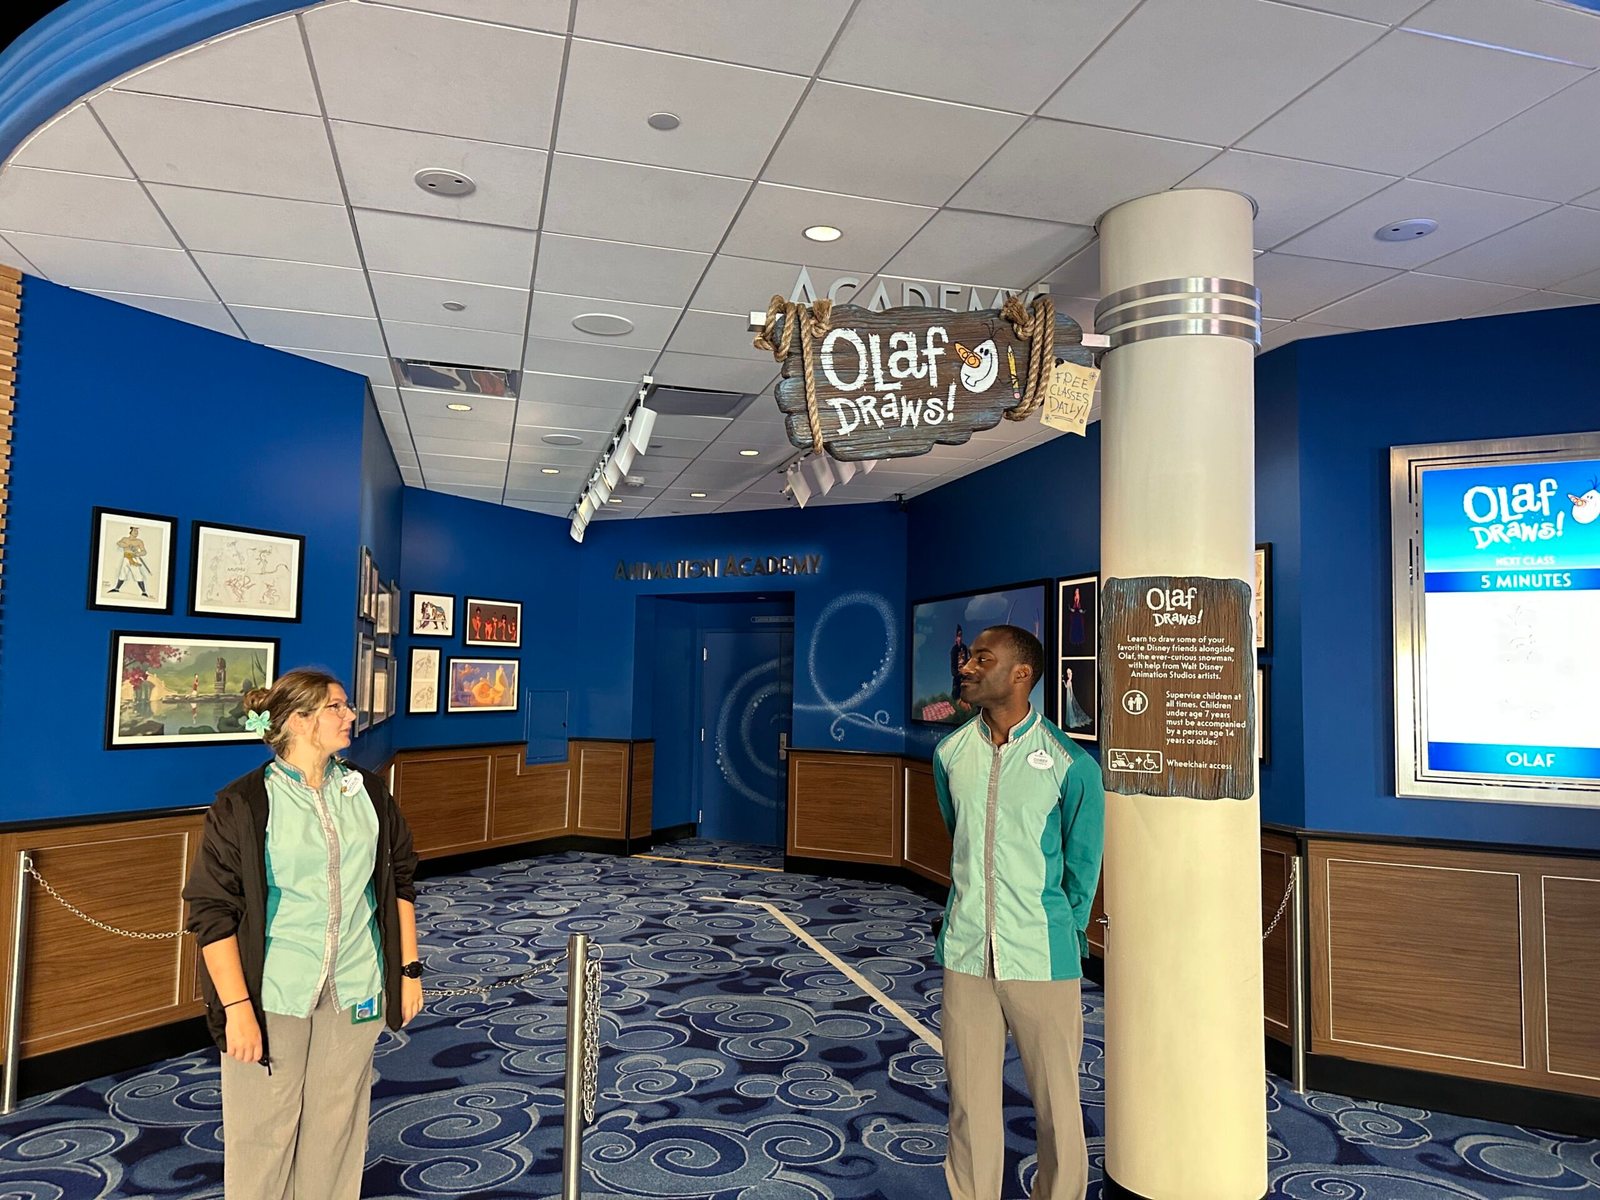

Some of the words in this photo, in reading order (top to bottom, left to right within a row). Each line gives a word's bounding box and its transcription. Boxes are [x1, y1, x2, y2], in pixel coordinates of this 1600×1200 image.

[1049, 383, 1090, 404] CLASSES
[1048, 395, 1089, 425] DAILY!
[1522, 554, 1555, 565] CLASS
[614, 558, 719, 581] ANIMATION
[723, 553, 823, 577] ACADEMY
[1481, 575, 1491, 588] 5
[1495, 572, 1571, 588] MINUTES
[1127, 635, 1147, 643] Learn
[1198, 636, 1207, 644] of
[1208, 638, 1225, 646] your
[1147, 644, 1171, 654] Disney
[1199, 645, 1235, 655] alongside
[1118, 652, 1137, 661] Olaf,
[1151, 654, 1197, 662] ever-curious
[1198, 655, 1235, 663] snowman,
[1144, 662, 1161, 671] help
[1181, 662, 1197, 670] Walt
[1199, 663, 1224, 673] Disney
[1130, 670, 1168, 678] Animation
[1169, 671, 1196, 679] Studios
[1197, 672, 1221, 680] artists.
[1165, 690, 1201, 701] Supervise
[1202, 691, 1233, 700] children
[1233, 693, 1242, 701] at
[1165, 700, 1175, 708] all
[1176, 701, 1198, 709] times.
[1199, 700, 1232, 710] Children
[1166, 709, 1188, 717] under
[1188, 711, 1203, 720] age
[1204, 709, 1210, 718] 7
[1210, 711, 1231, 720] years
[1184, 718, 1196, 726] be
[1196, 720, 1247, 730] accompanied
[1166, 727, 1176, 737] by
[1182, 728, 1208, 737] person
[1209, 730, 1224, 739] age
[1225, 728, 1235, 737] 14
[1166, 737, 1186, 746] years
[1196, 737, 1219, 746] older.
[1166, 758, 1208, 768] Wheelchair
[1208, 761, 1233, 770] access
[1505, 751, 1556, 768] OLAF
